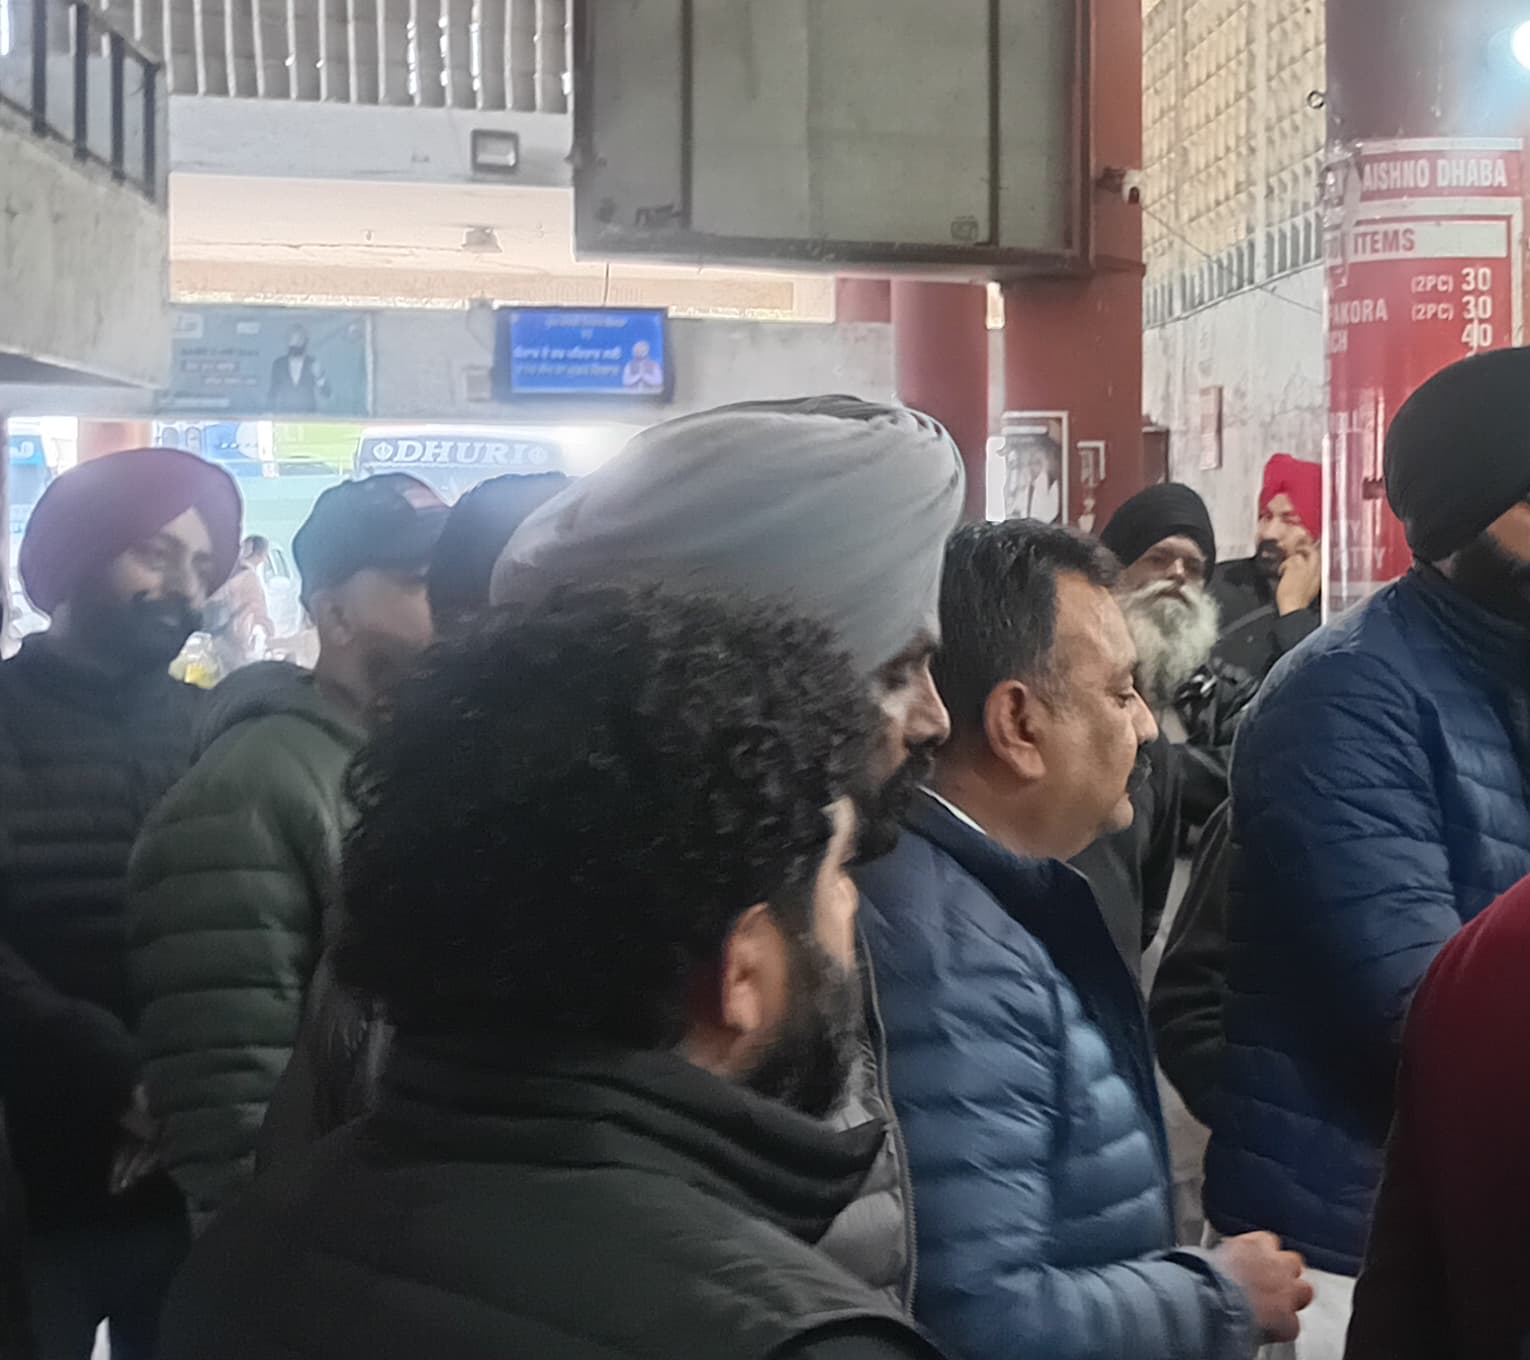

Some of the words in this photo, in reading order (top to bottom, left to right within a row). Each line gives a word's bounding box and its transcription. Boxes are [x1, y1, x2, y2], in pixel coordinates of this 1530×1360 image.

[1436, 159, 1508, 188] DHABA
[1352, 228, 1416, 255] ITEMS
[1411, 274, 1454, 294] (2PC)
[1461, 268, 1492, 291] 30
[1411, 302, 1455, 321] (2PC)
[1461, 295, 1493, 319] 30
[1461, 322, 1493, 348] 40
[394, 440, 529, 465] DHURI
